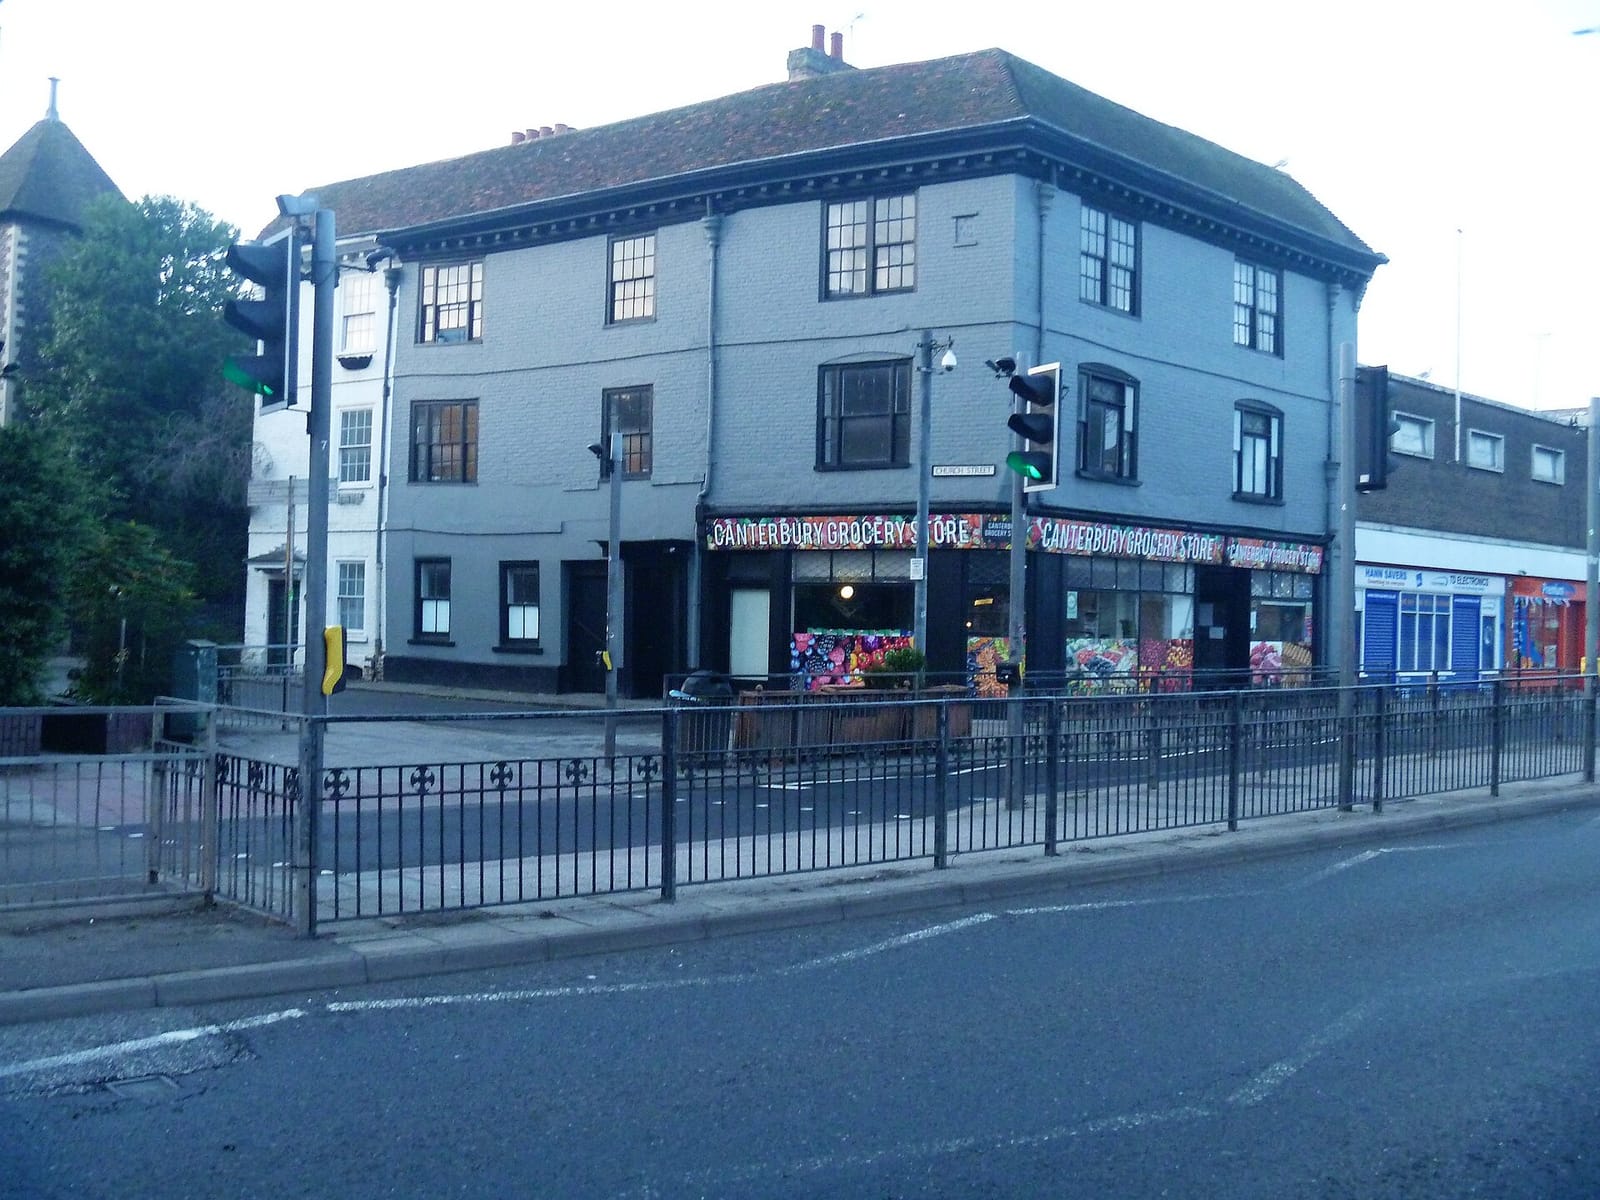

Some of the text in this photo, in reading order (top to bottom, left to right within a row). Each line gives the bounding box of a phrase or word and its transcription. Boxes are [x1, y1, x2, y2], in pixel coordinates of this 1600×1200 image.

[714, 522, 823, 546] CANTERBURY
[827, 520, 906, 544] GROCERY
[1042, 522, 1215, 561] CANTERBURY GROCERY STORE
